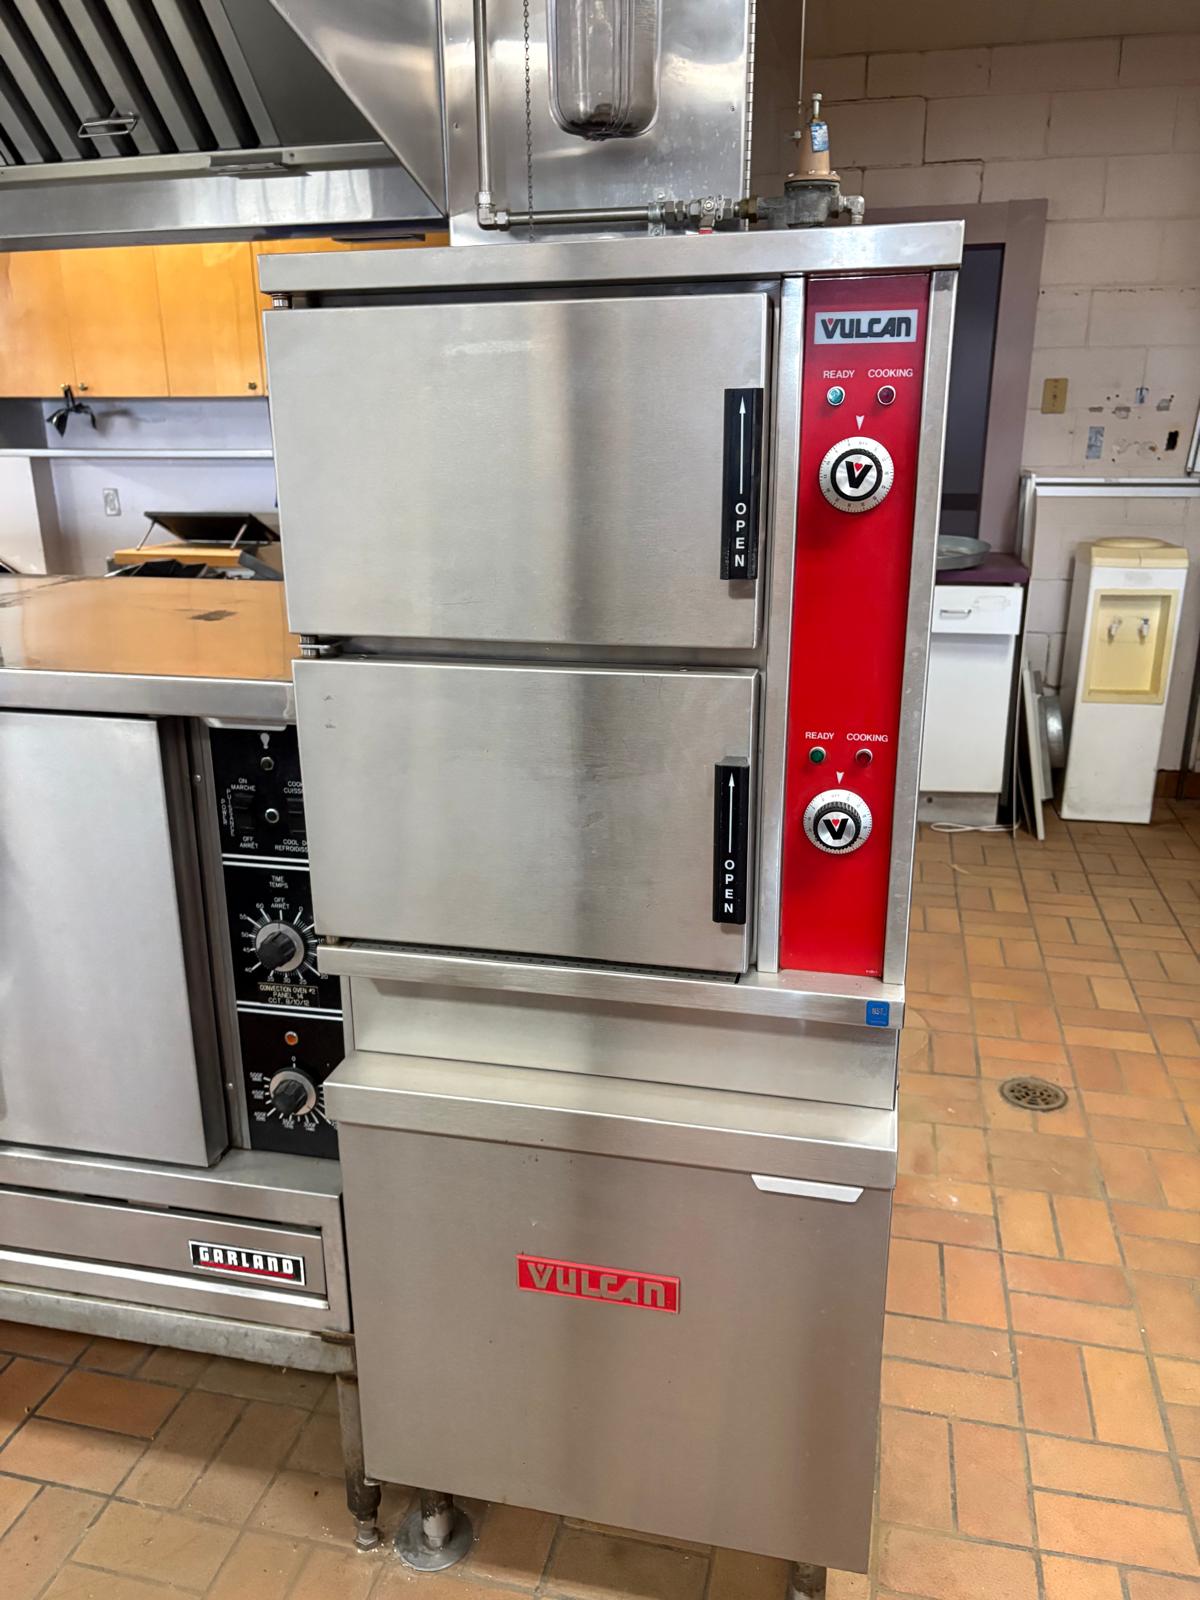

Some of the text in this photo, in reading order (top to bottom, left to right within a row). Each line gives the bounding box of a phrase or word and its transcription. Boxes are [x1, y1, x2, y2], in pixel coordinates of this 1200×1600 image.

[821, 317, 912, 339] VULCAN
[823, 369, 913, 379] READY COOKING
[735, 502, 747, 567] OPEN
[805, 732, 888, 742] READY COOKING
[724, 860, 735, 914] OPEN
[273, 990, 295, 999] PANEL
[199, 1246, 294, 1274] GARLAND
[527, 1262, 665, 1307] VULCAN
